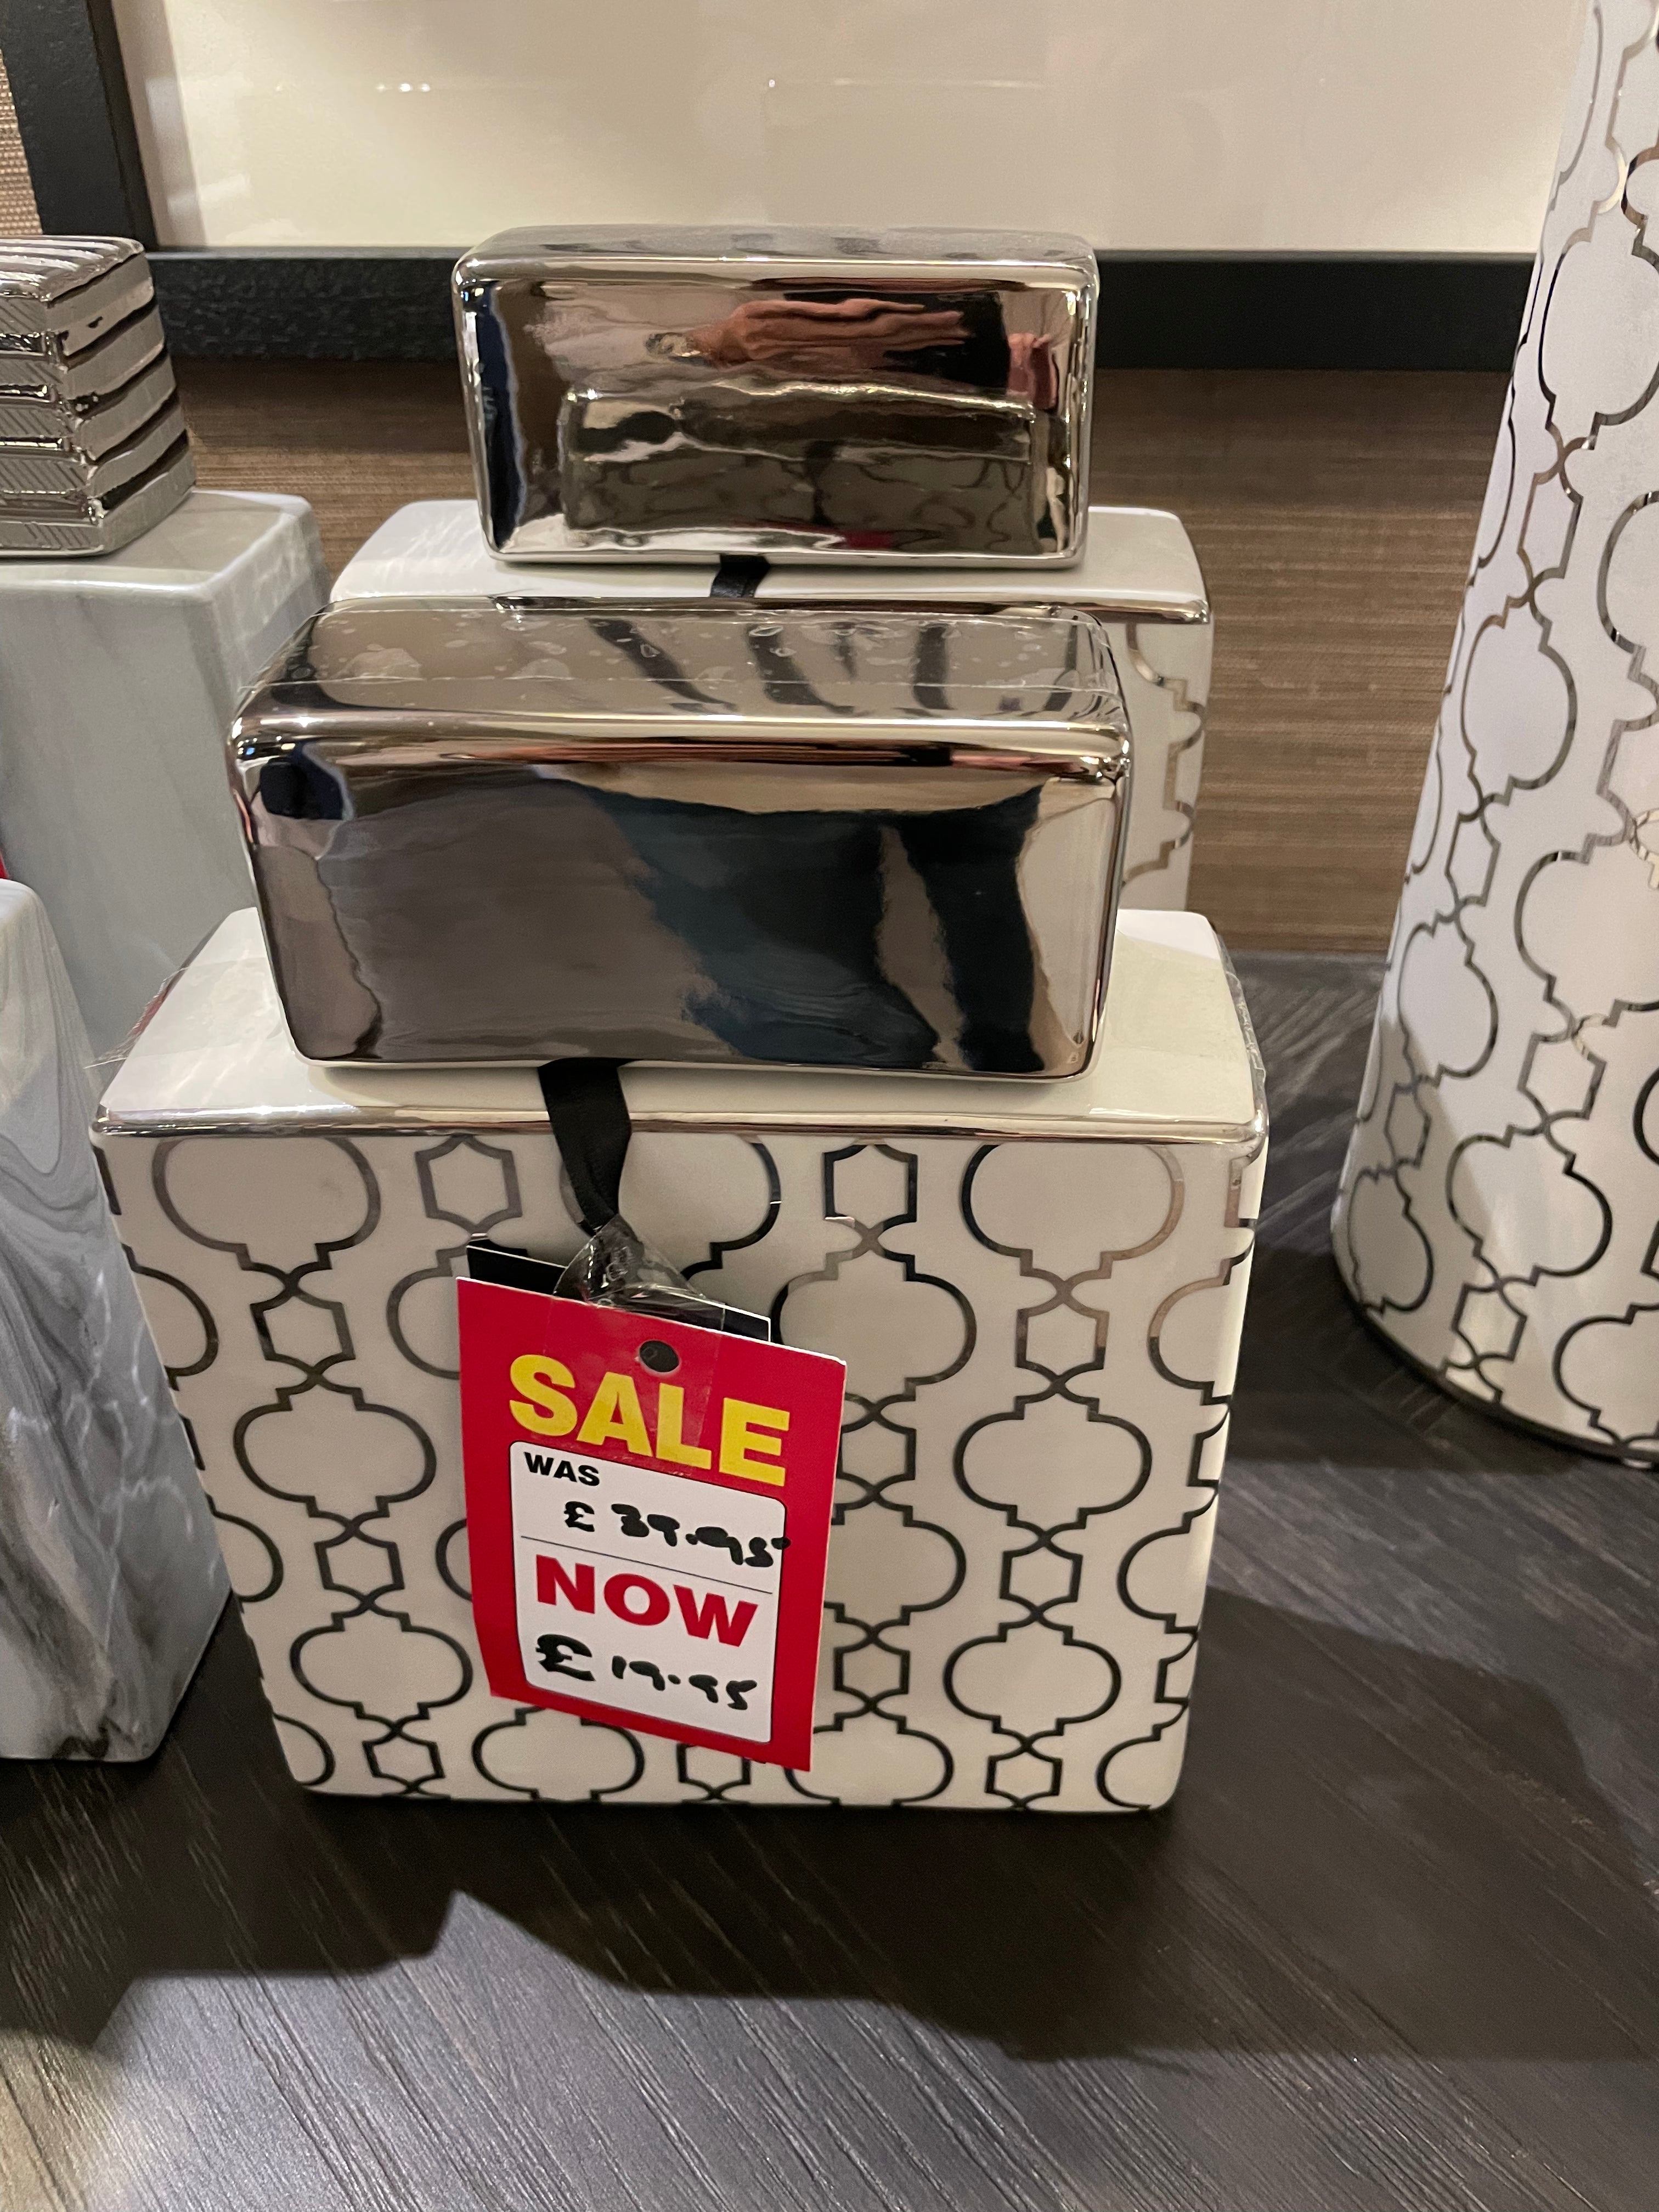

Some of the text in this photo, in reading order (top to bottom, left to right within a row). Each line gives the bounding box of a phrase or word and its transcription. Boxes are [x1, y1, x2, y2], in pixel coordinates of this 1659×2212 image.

[510, 1354, 789, 1486] SALE
[524, 1451, 600, 1487] WAS
[535, 1554, 759, 1647] NOW
